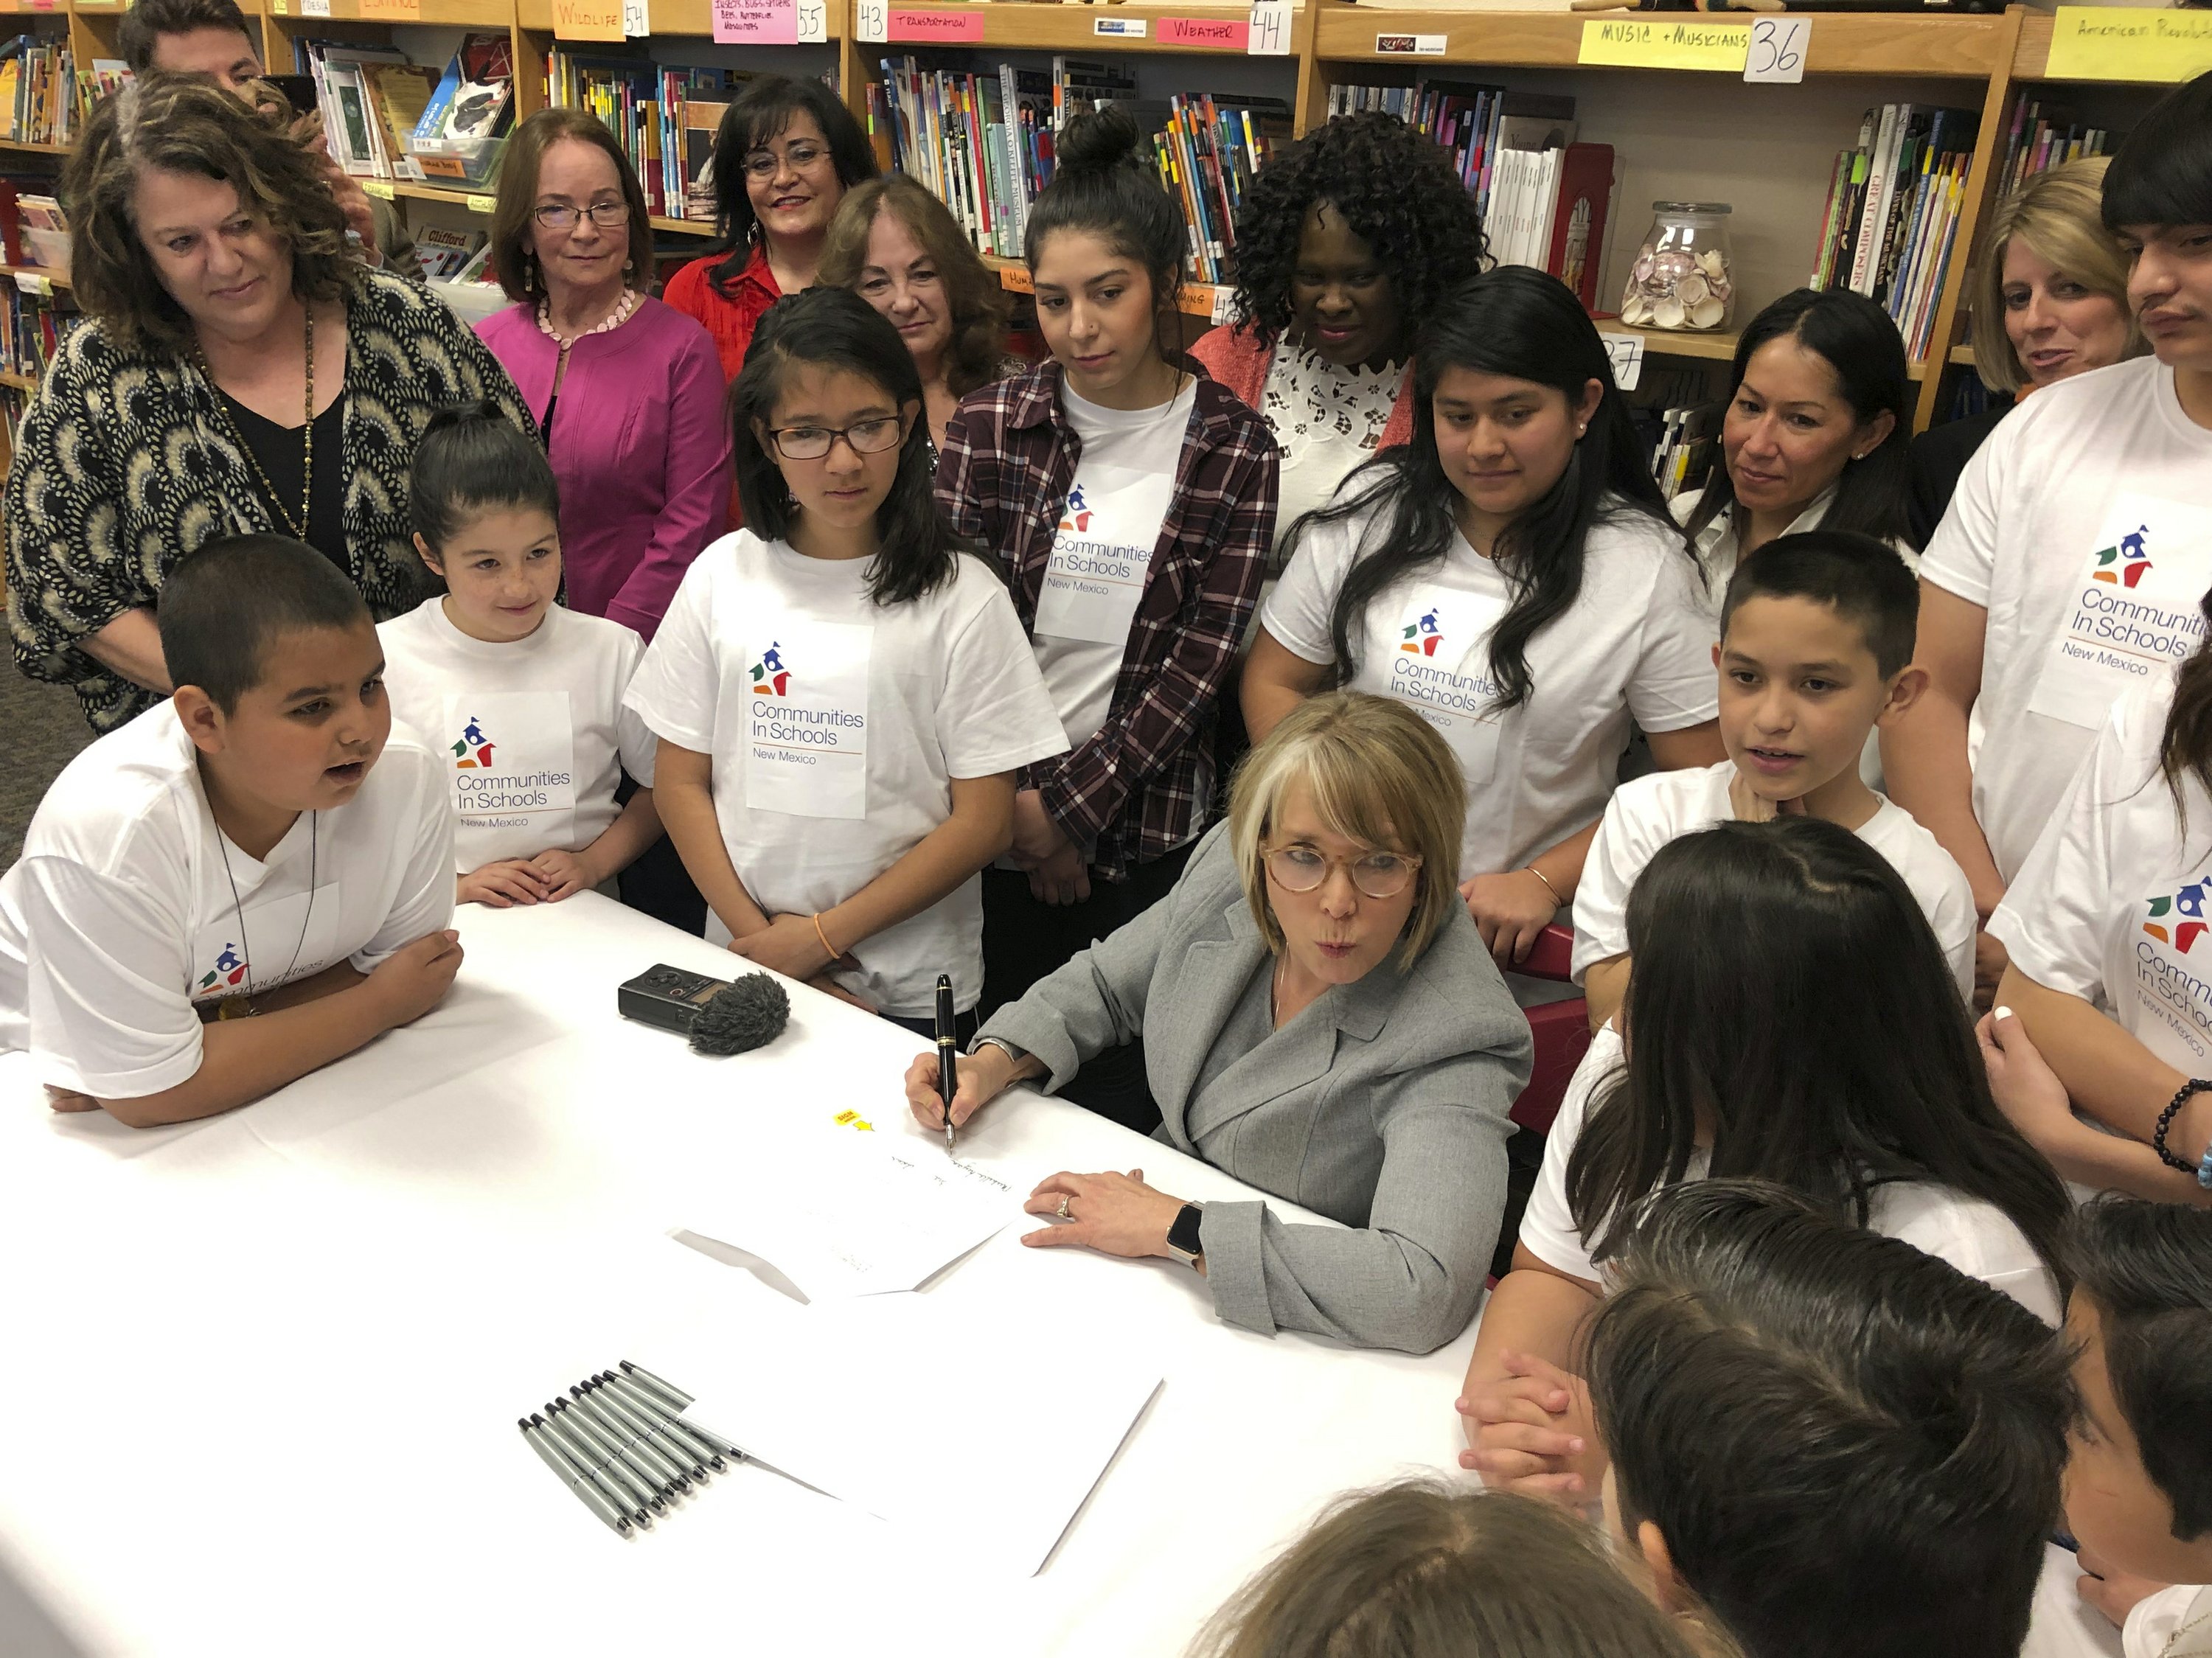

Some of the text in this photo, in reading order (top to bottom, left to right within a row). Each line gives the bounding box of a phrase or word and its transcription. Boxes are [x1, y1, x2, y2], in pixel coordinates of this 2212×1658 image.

[557, 5, 617, 26] WILDLIFE
[625, 7, 644, 32] 54
[799, 7, 822, 36] 55
[861, 4, 883, 36] 43
[896, 16, 966, 28] TRANSPORTATION
[1174, 19, 1234, 38] WEATHER
[2077, 18, 2150, 38] American
[1253, 10, 1281, 49] 44
[1601, 24, 1652, 43] MUSIC
[1754, 21, 1800, 72] 36
[1000, 73, 1022, 227] THE GEORGIA O'KEEFFE MUSEUM
[428, 229, 467, 246] Clifford
[1853, 175, 1882, 288] GREAT COMPOSERS
[1877, 242, 1893, 286] MUSICIANS
[1053, 535, 1154, 563] Communities
[1049, 552, 1130, 578] In Schools
[1047, 577, 1109, 596] New Mexico
[2081, 588, 2206, 636] Communiti
[2072, 610, 2188, 657] In Schools
[2062, 641, 2149, 676] New Mexico
[1394, 657, 1498, 697] Communitie
[1391, 676, 1476, 711] In Schools
[753, 700, 864, 728] Communities
[753, 720, 838, 745] In Schools
[753, 748, 816, 764] New Mexico
[456, 770, 570, 791] Communities
[459, 790, 547, 809] In Schools
[460, 818, 529, 828] New Mexico
[2136, 941, 2212, 1008] Comm
[2138, 961, 2154, 988] In
[2138, 990, 2205, 1058] New Mexico
[838, 1111, 854, 1121] SIGN
